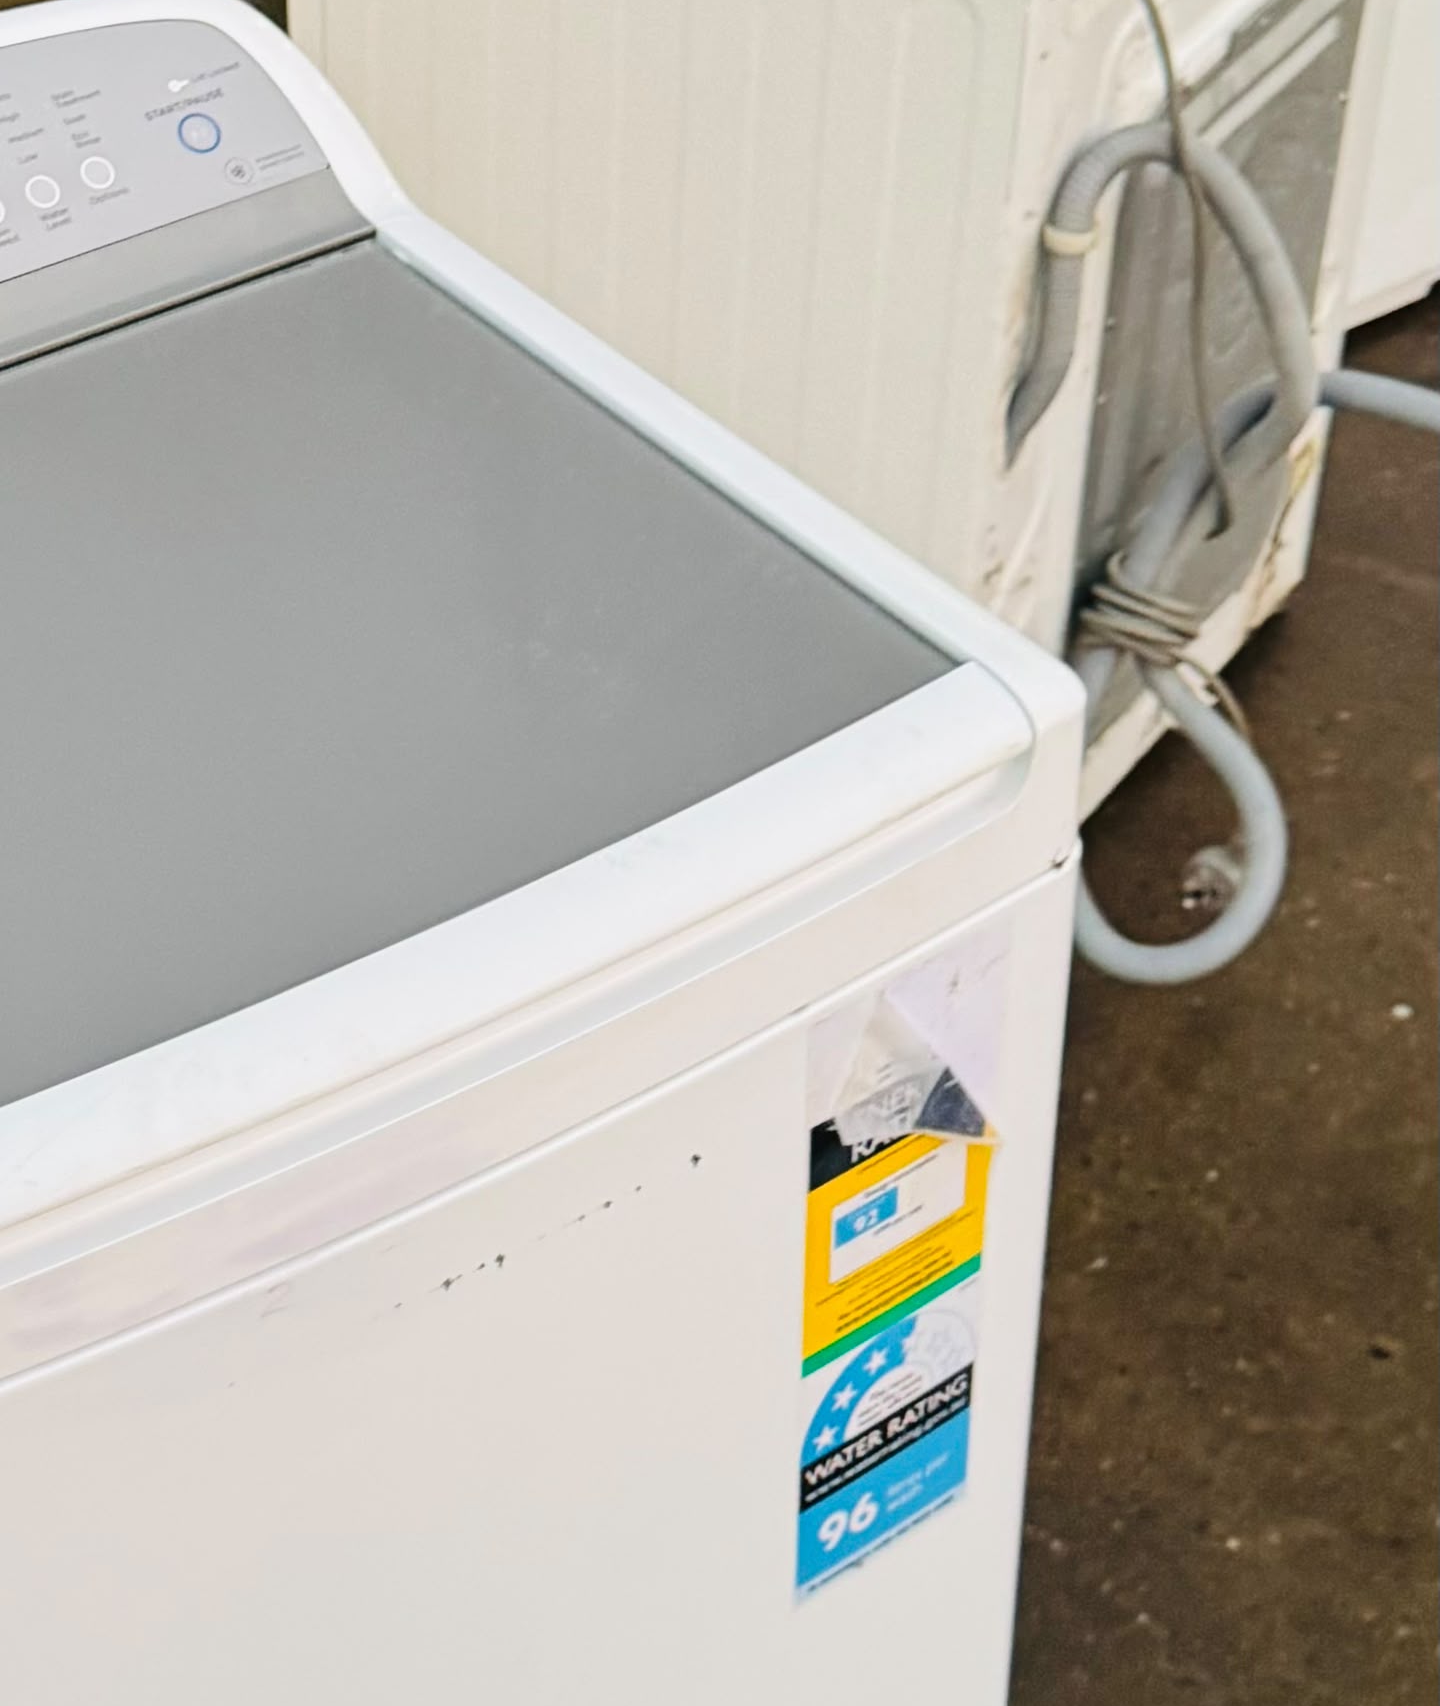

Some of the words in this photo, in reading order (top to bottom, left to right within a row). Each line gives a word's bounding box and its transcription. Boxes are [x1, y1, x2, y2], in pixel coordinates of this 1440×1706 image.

[804, 1428, 884, 1486] WATER
[886, 1373, 969, 1439] RATING
[817, 1492, 879, 1553] 96
